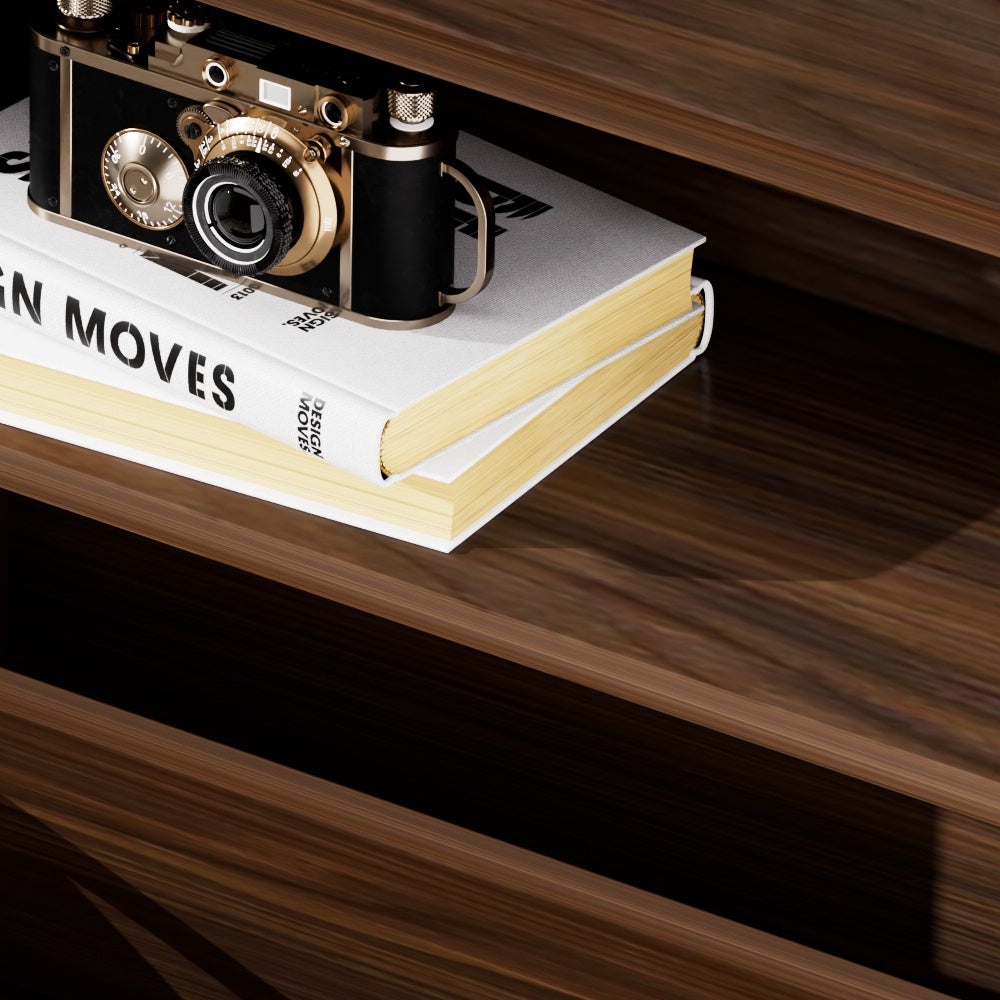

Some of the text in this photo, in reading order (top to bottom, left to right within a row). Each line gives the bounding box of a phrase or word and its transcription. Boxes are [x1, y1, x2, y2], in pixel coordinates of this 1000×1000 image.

[230, 286, 256, 301] 013
[281, 306, 326, 327] OVES.
[297, 311, 340, 333] SIGN
[64, 295, 236, 412] MOVES
[297, 391, 314, 453] MOVES
[310, 397, 326, 459] DESIGN
